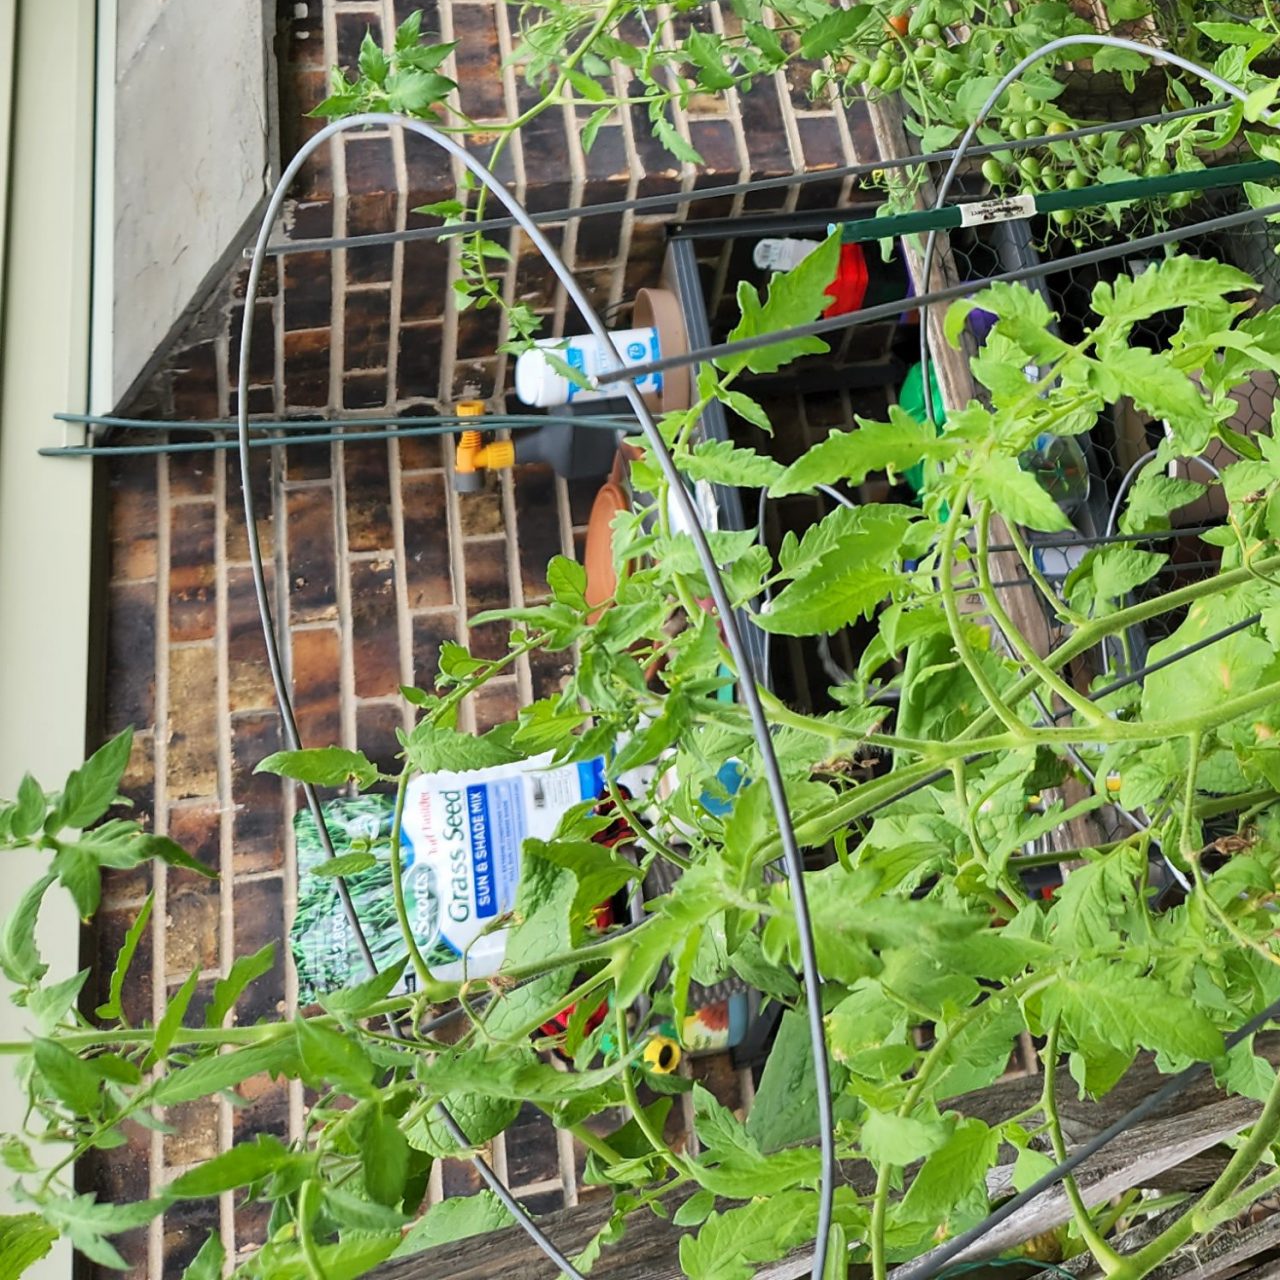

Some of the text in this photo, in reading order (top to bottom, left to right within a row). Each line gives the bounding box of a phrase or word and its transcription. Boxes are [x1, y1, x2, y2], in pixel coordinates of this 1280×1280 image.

[413, 871, 430, 936] Scotts
[439, 790, 470, 922] Grass Seed
[469, 791, 491, 907] SUN & SHADE MIX
